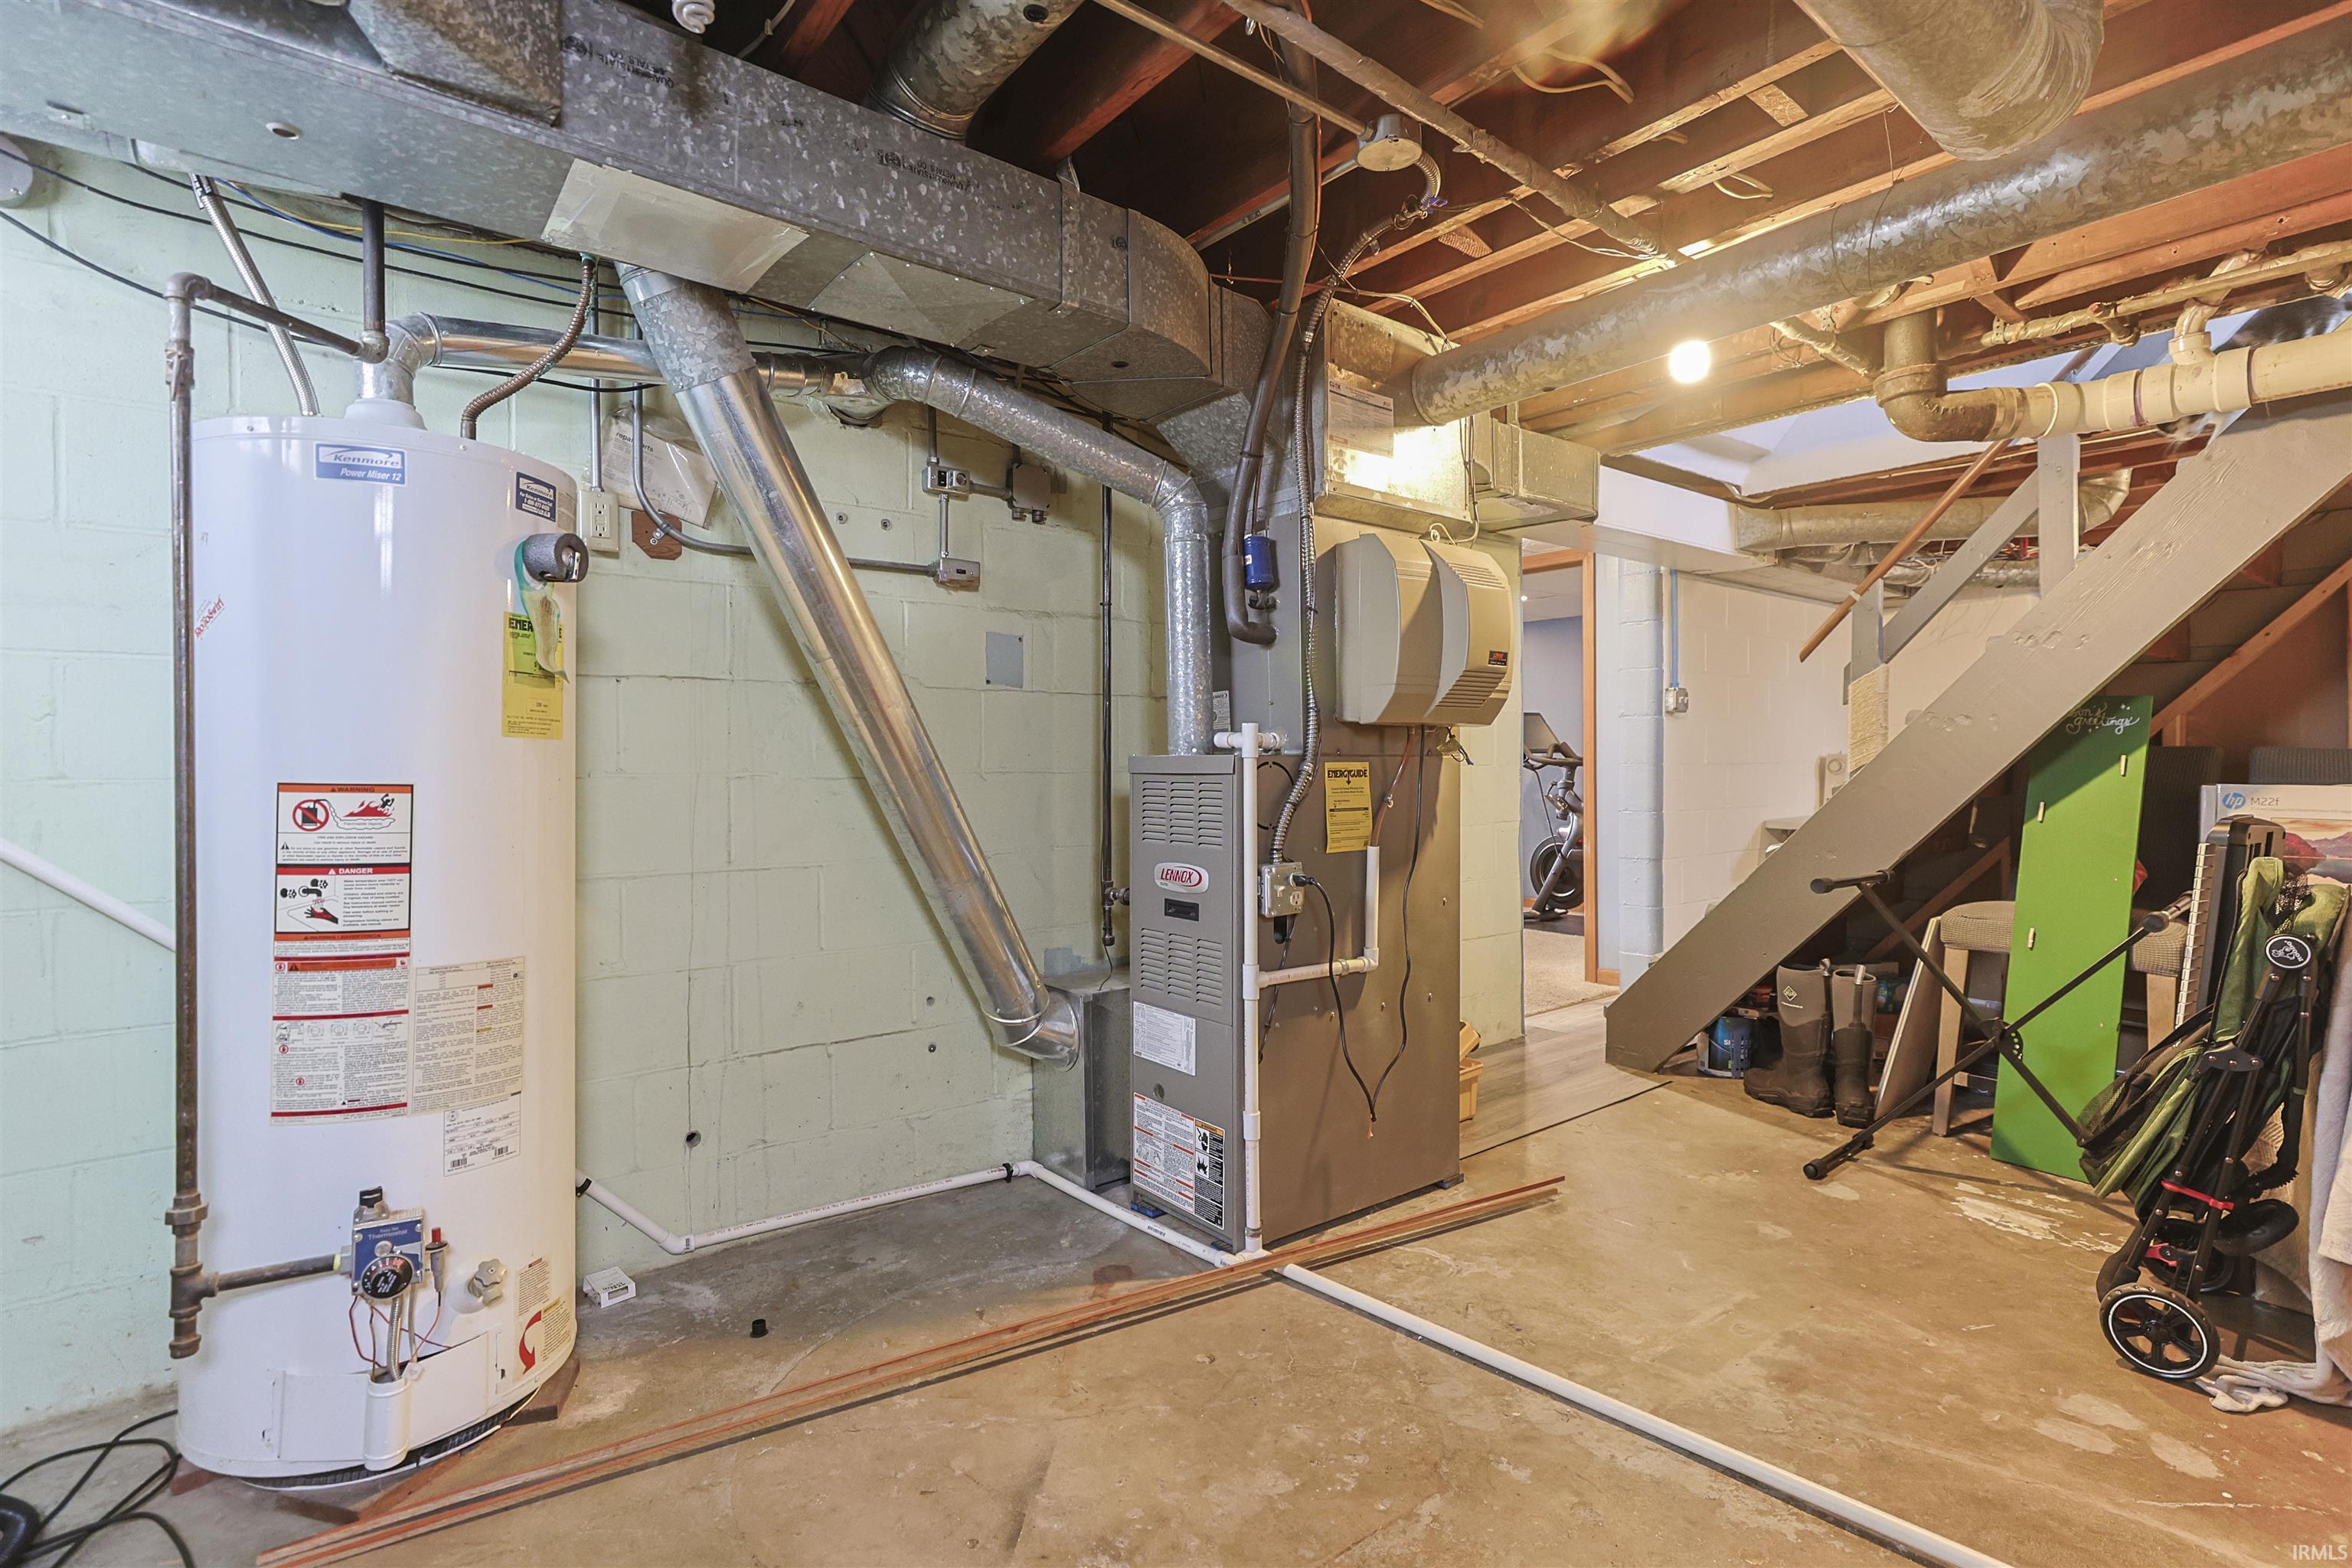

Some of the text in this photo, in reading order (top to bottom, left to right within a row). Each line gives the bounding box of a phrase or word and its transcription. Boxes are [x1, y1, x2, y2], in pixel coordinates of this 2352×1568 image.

[333, 454, 400, 467] Kenmore
[340, 468, 402, 481] Power Miser 12
[526, 484, 553, 498] Kenmore
[2066, 712, 2141, 735] greetings
[2226, 792, 2243, 810] hp
[1160, 867, 1194, 884] LENNOX
[368, 1230, 408, 1240] Thermostat
